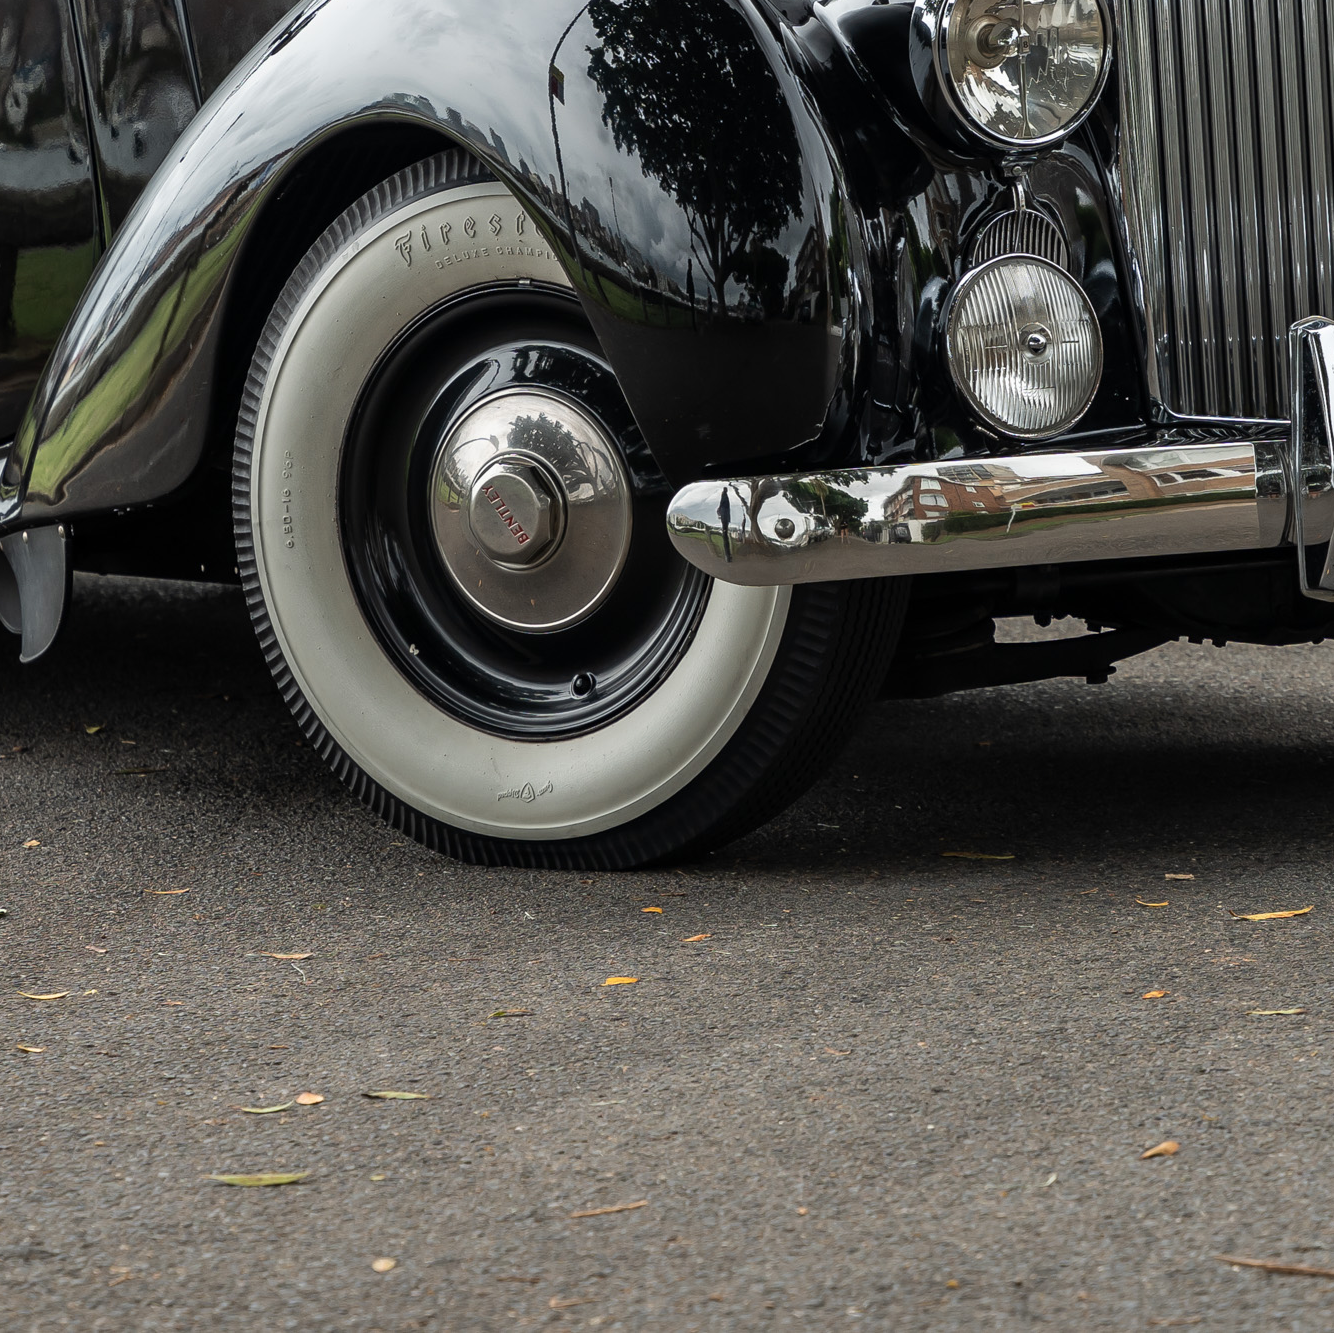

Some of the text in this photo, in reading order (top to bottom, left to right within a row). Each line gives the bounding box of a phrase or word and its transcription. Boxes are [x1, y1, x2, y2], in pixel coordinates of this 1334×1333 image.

[434, 246, 489, 270] DELUXE
[281, 488, 295, 549] 6.50-16
[482, 485, 530, 546] BENTLEY
